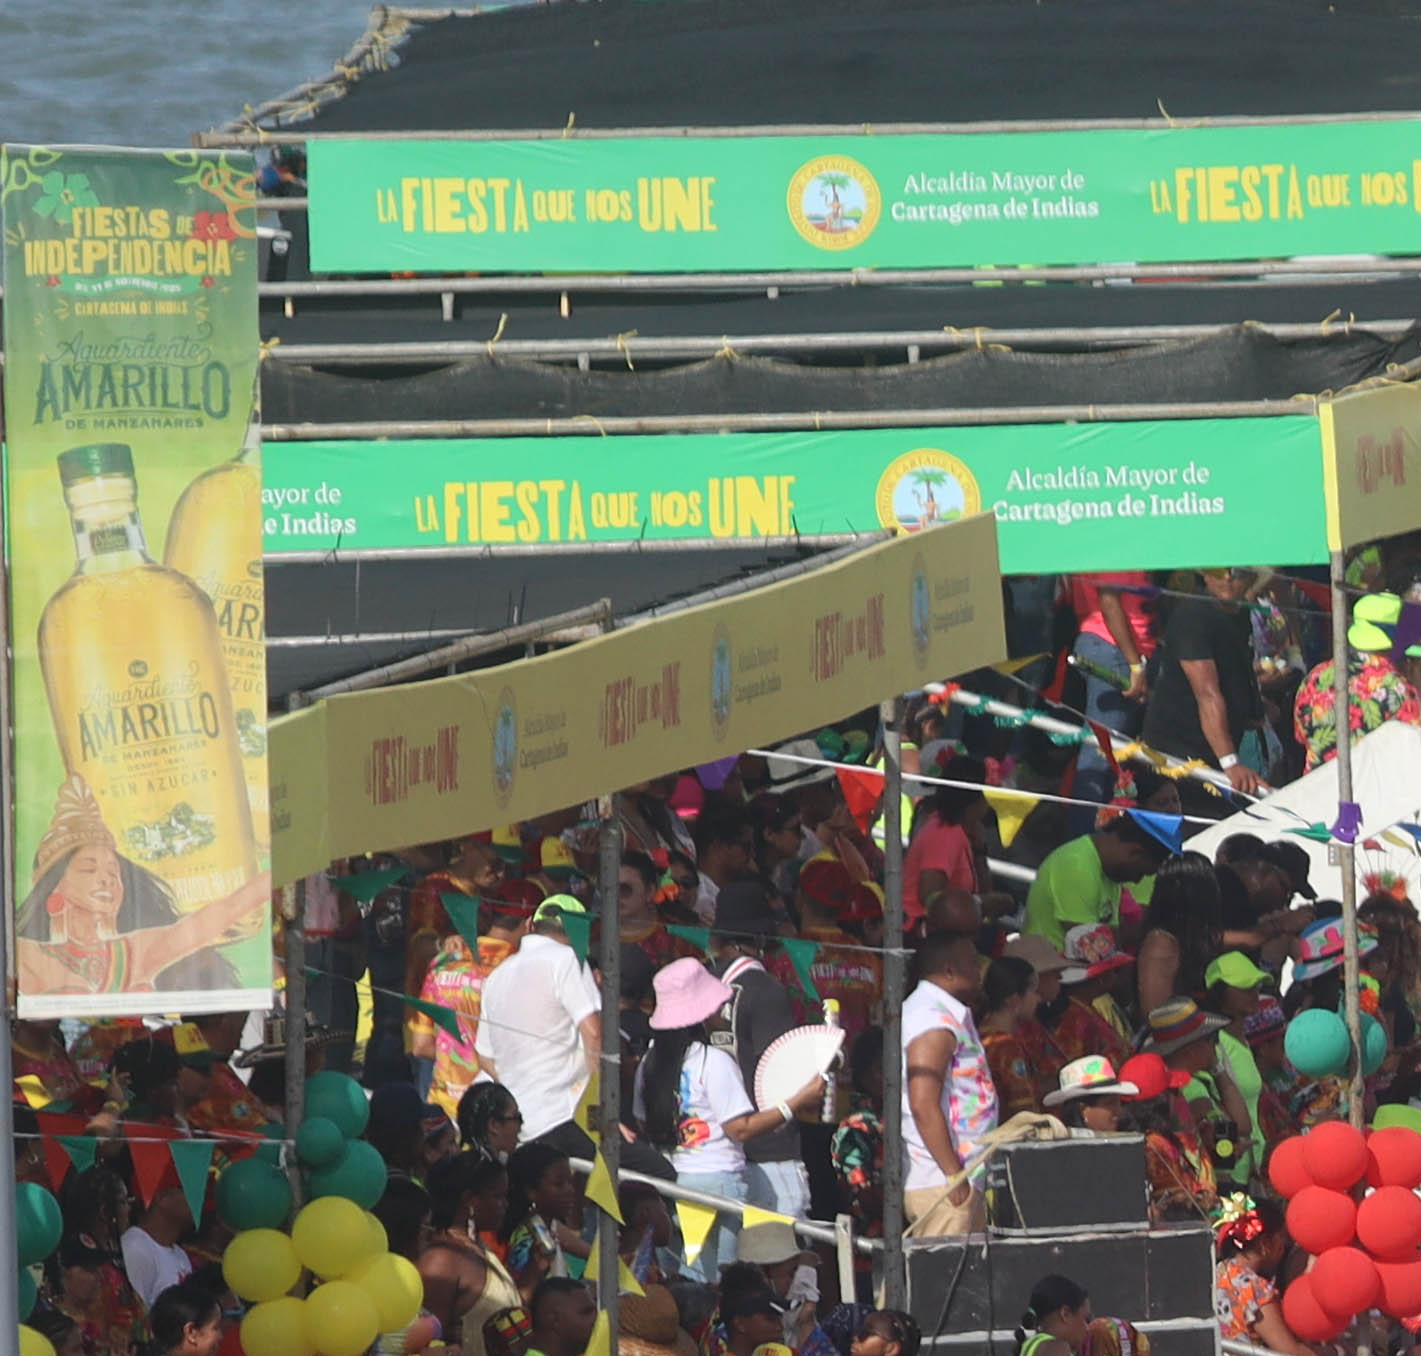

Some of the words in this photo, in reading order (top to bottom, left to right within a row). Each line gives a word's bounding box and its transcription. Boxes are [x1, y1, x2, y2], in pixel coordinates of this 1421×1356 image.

[991, 170, 1057, 196] Mayor
[1060, 167, 1085, 190] de
[1151, 180, 1172, 214] LA
[1175, 164, 1303, 223] FIESTA
[1308, 174, 1351, 208] QUE
[1361, 172, 1407, 206] NOS
[377, 189, 397, 223] LA
[400, 177, 530, 234] FIESTA
[533, 188, 576, 223] QUE
[586, 187, 634, 222] NOS
[637, 176, 717, 233] UNE
[891, 199, 1000, 225] Cartagena
[1003, 197, 1028, 219] de
[1031, 196, 1100, 219] Indias
[72, 206, 171, 239] FIESTAS
[176, 215, 194, 236] DE
[24, 239, 232, 277] INDEPENDENCIA
[47, 321, 213, 369] Aguardiente
[33, 360, 231, 426] AMARILLO
[93, 416, 205, 430] MANZANARES
[1006, 466, 1100, 492] Alcaldía
[1104, 464, 1178, 491] Mayor
[1182, 461, 1210, 485] de
[261, 482, 309, 508] ayor
[313, 482, 342, 503] de
[415, 495, 439, 533] LA
[443, 480, 587, 543] FIESTA
[590, 491, 638, 528] QUE
[650, 490, 703, 528] NOS
[708, 475, 796, 538] UNE
[993, 501, 1114, 525] Cartagena
[1117, 496, 1147, 519] de
[1150, 493, 1225, 517] Indias
[261, 511, 278, 534] e
[281, 511, 357, 535] Indias
[78, 691, 220, 763] AMARILLO
[110, 780, 138, 798] SIN
